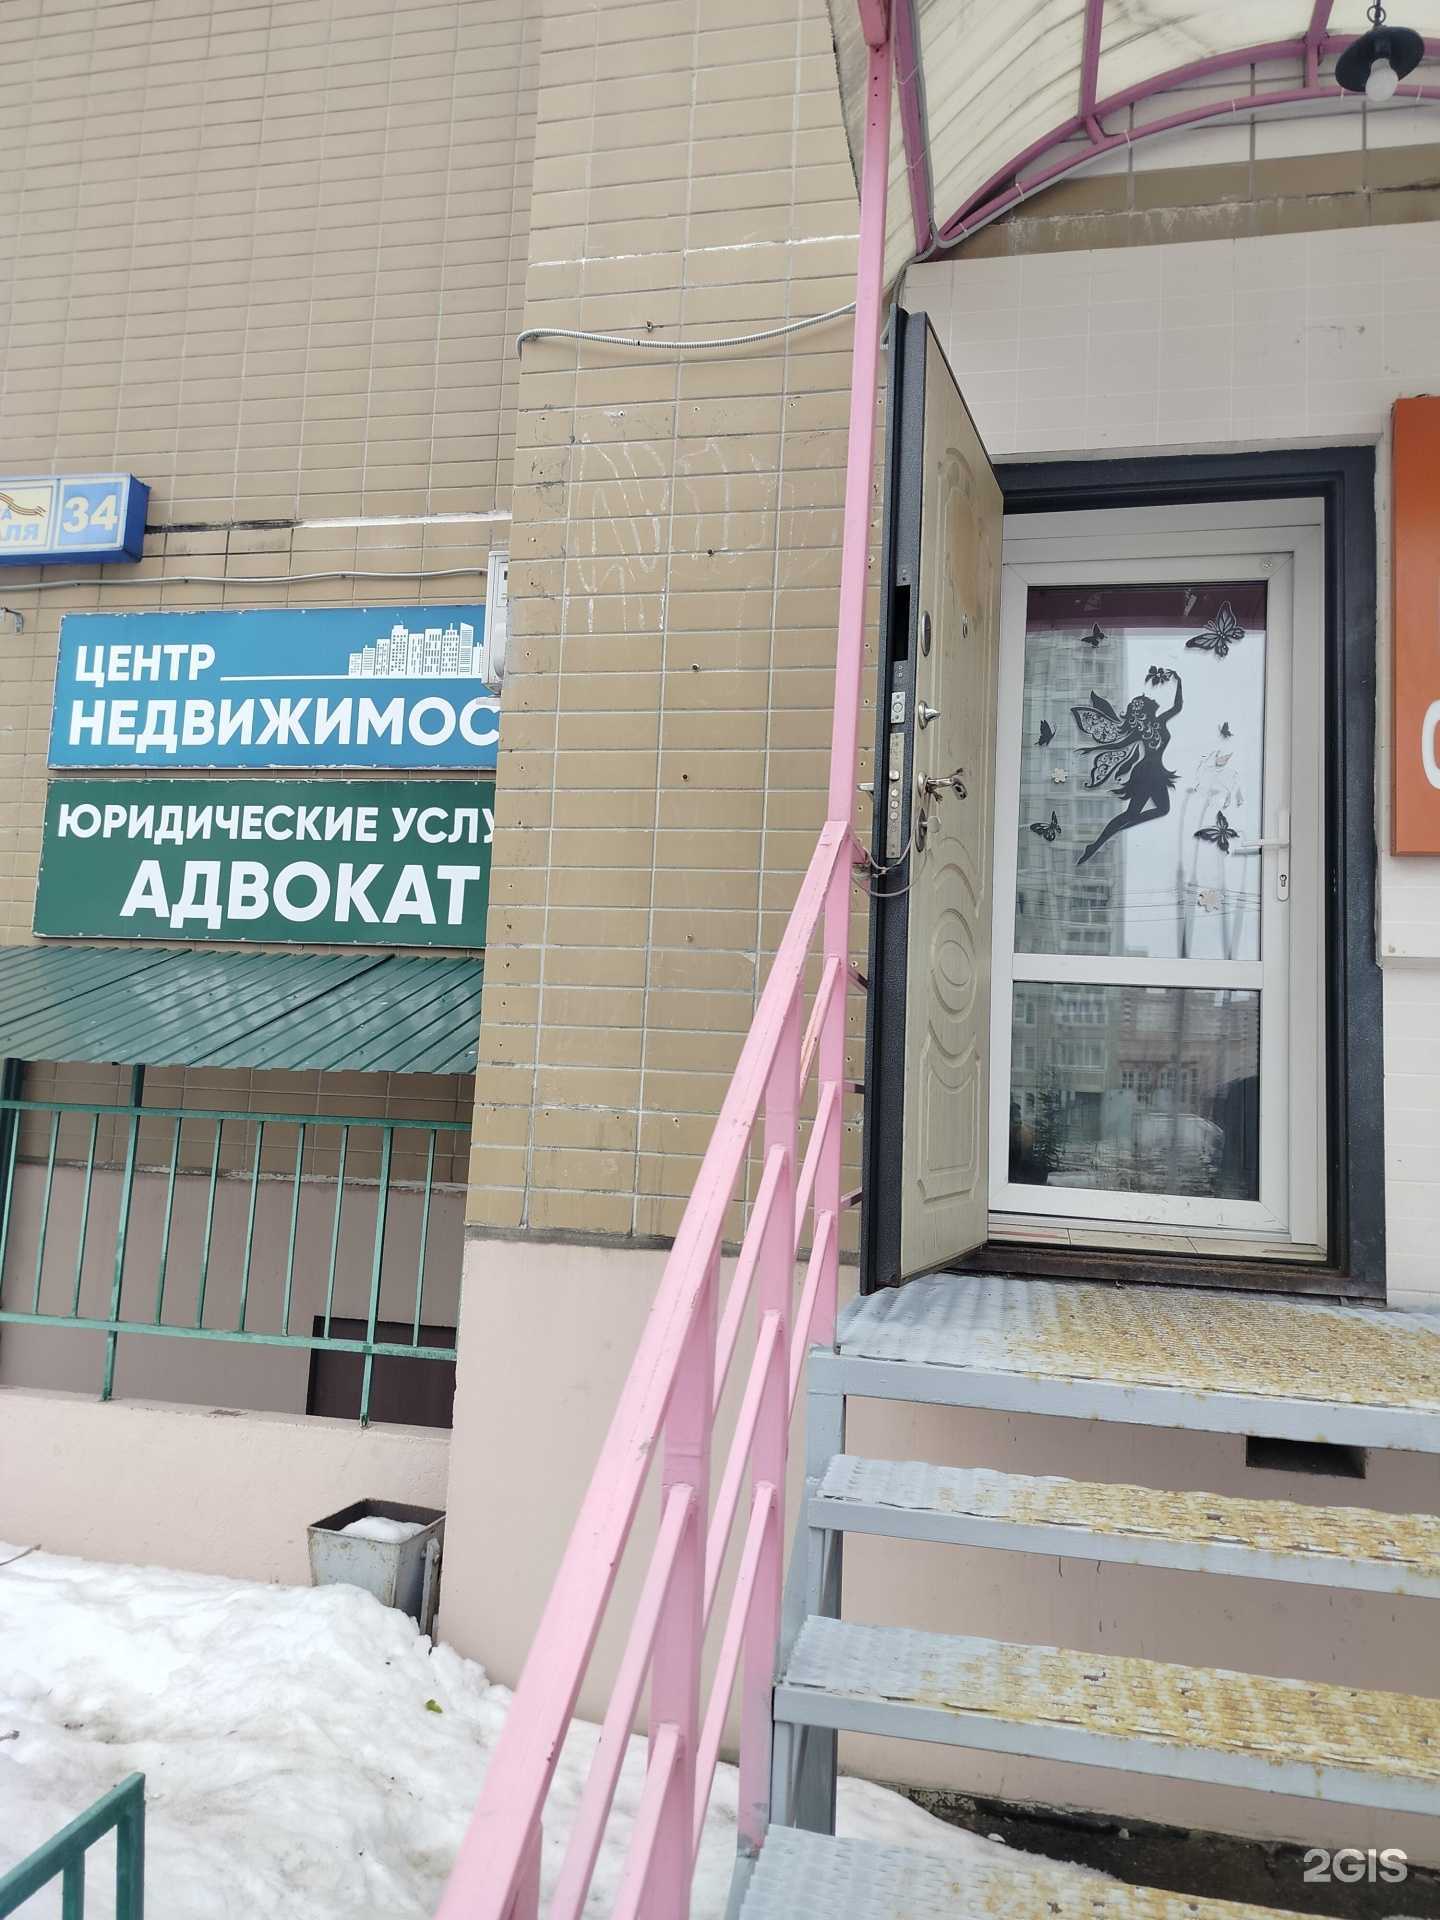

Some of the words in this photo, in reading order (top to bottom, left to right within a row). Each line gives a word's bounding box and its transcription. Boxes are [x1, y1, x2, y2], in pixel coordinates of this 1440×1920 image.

[0, 523, 39, 542] ЛЯ
[63, 495, 118, 534] 34
[75, 644, 216, 688] ЦЕНТР
[68, 696, 501, 754] НЕДВИЖИМОС
[56, 804, 377, 846] ЮРИДИЧЕСКИЕ
[119, 859, 481, 930] АДВОКАТ
